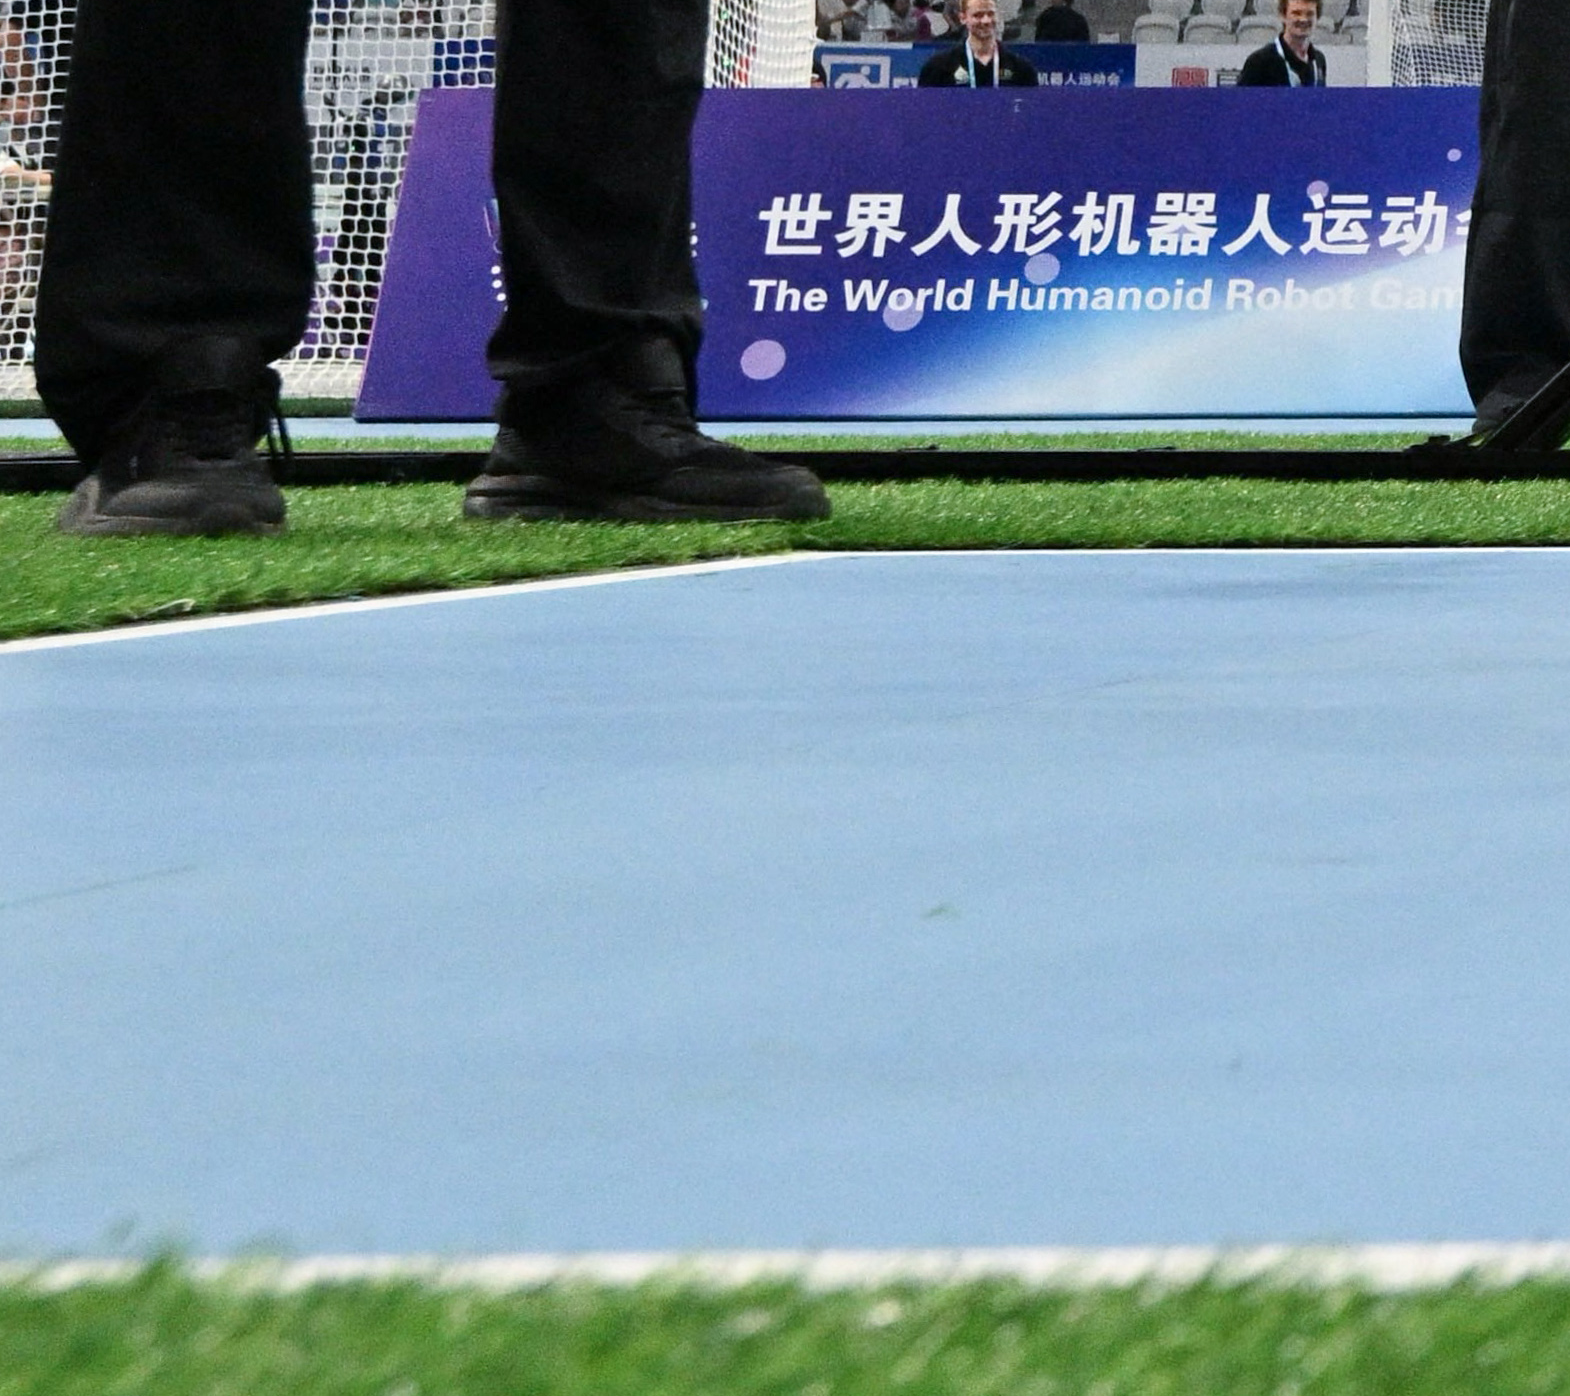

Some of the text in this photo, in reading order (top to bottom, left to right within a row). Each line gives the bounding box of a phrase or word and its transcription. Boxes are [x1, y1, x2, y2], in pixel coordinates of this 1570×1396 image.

[759, 191, 1472, 258] 世界人形机器人运动
[748, 279, 829, 312] The
[844, 279, 975, 312] World
[987, 279, 1213, 312] Humanoid
[1226, 278, 1355, 312] Robot
